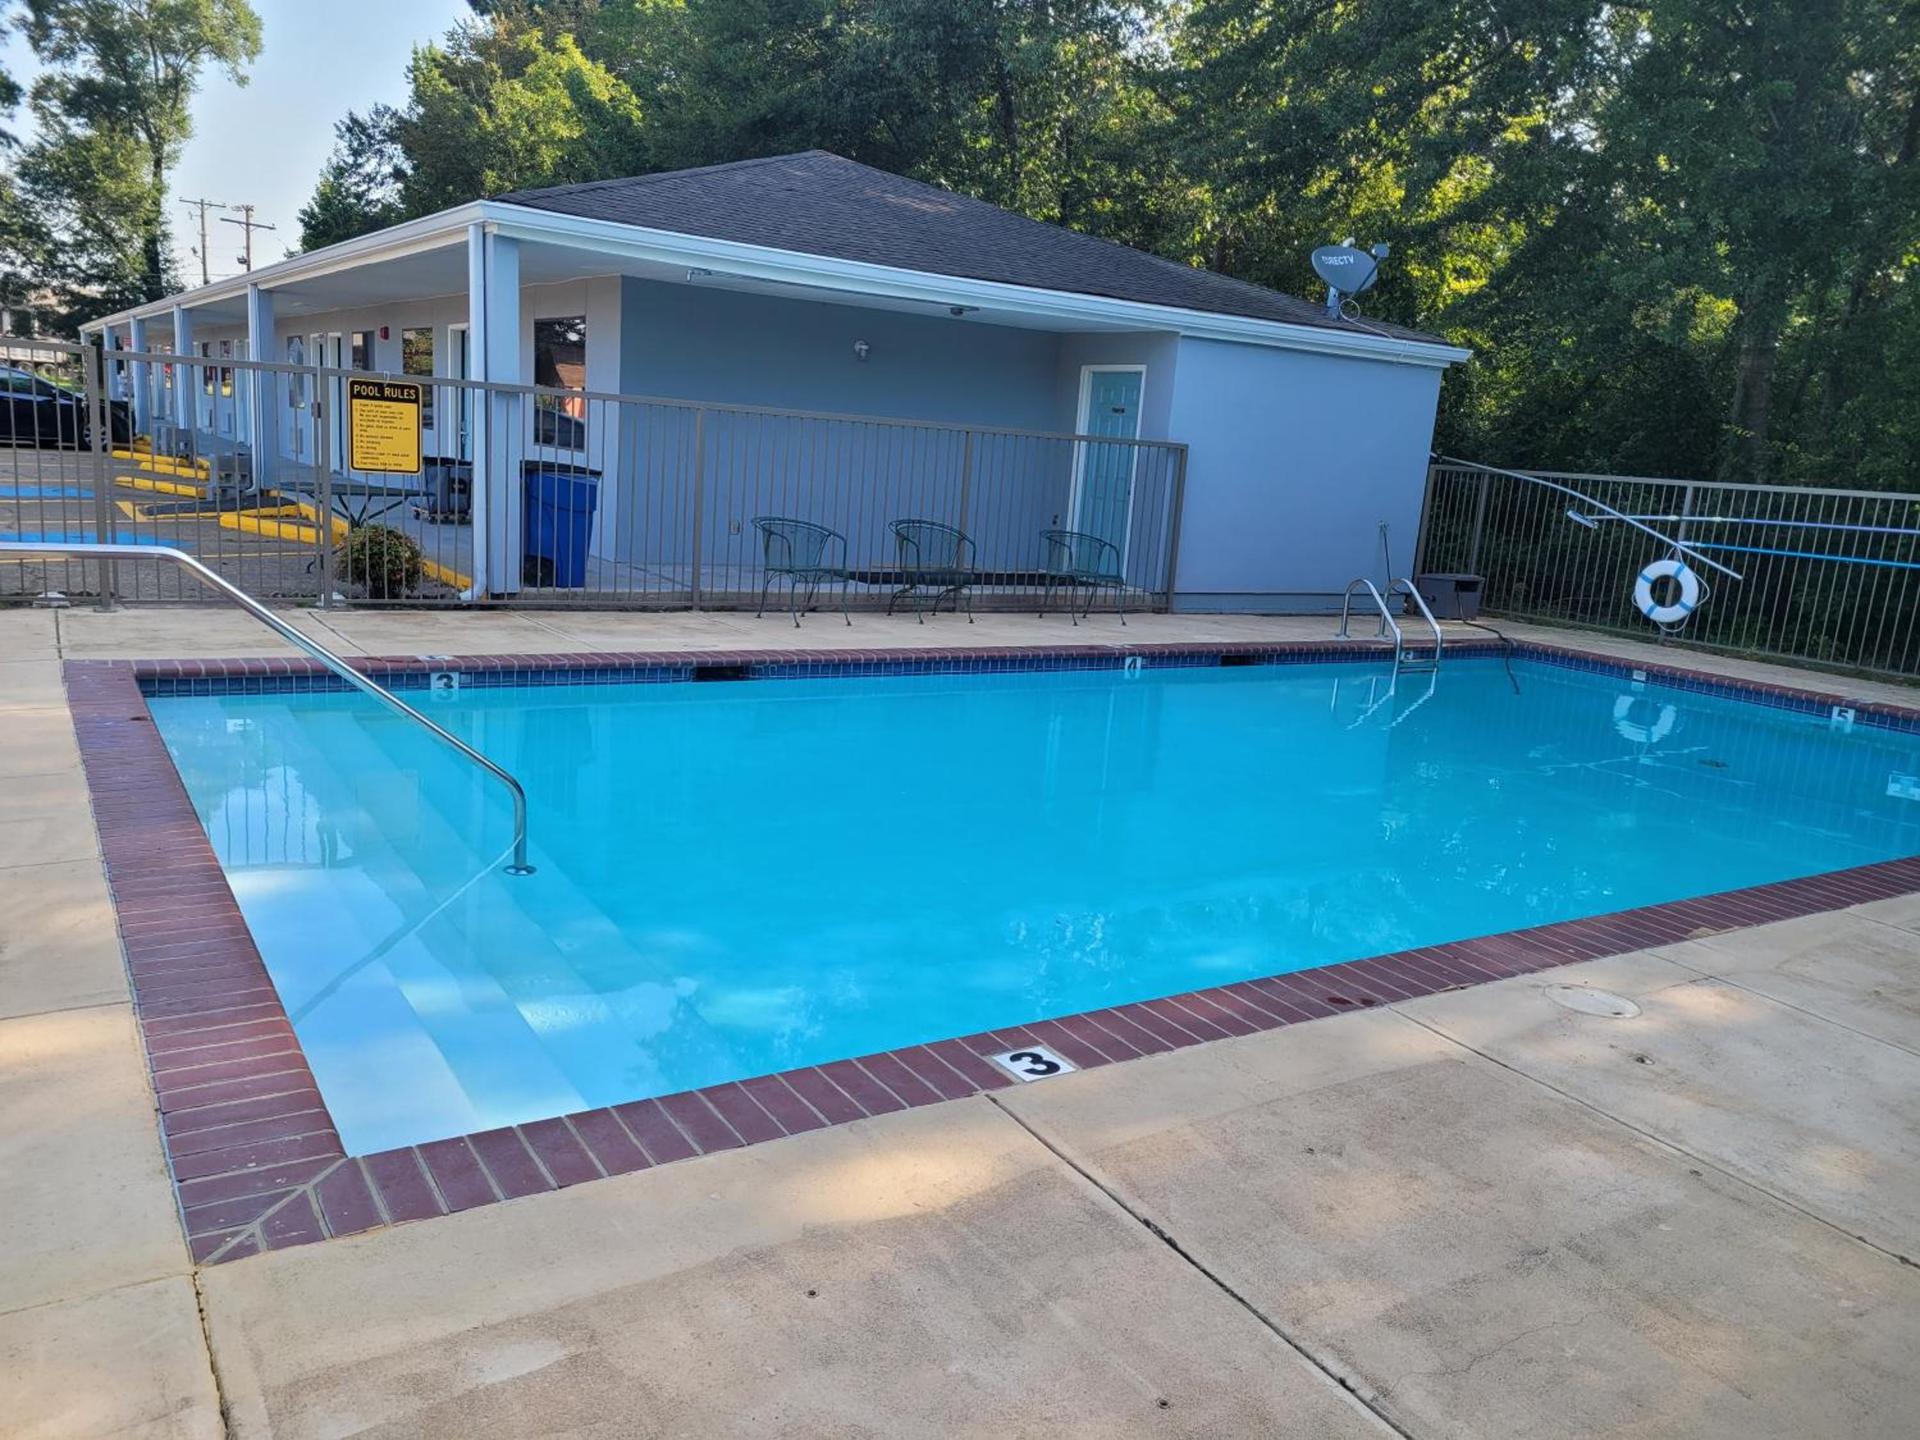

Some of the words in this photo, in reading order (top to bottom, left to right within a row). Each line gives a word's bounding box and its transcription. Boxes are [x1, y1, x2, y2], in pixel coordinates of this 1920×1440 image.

[353, 384, 381, 397] POOL
[384, 387, 416, 400] RULES
[1009, 1052, 1060, 1076] 3
